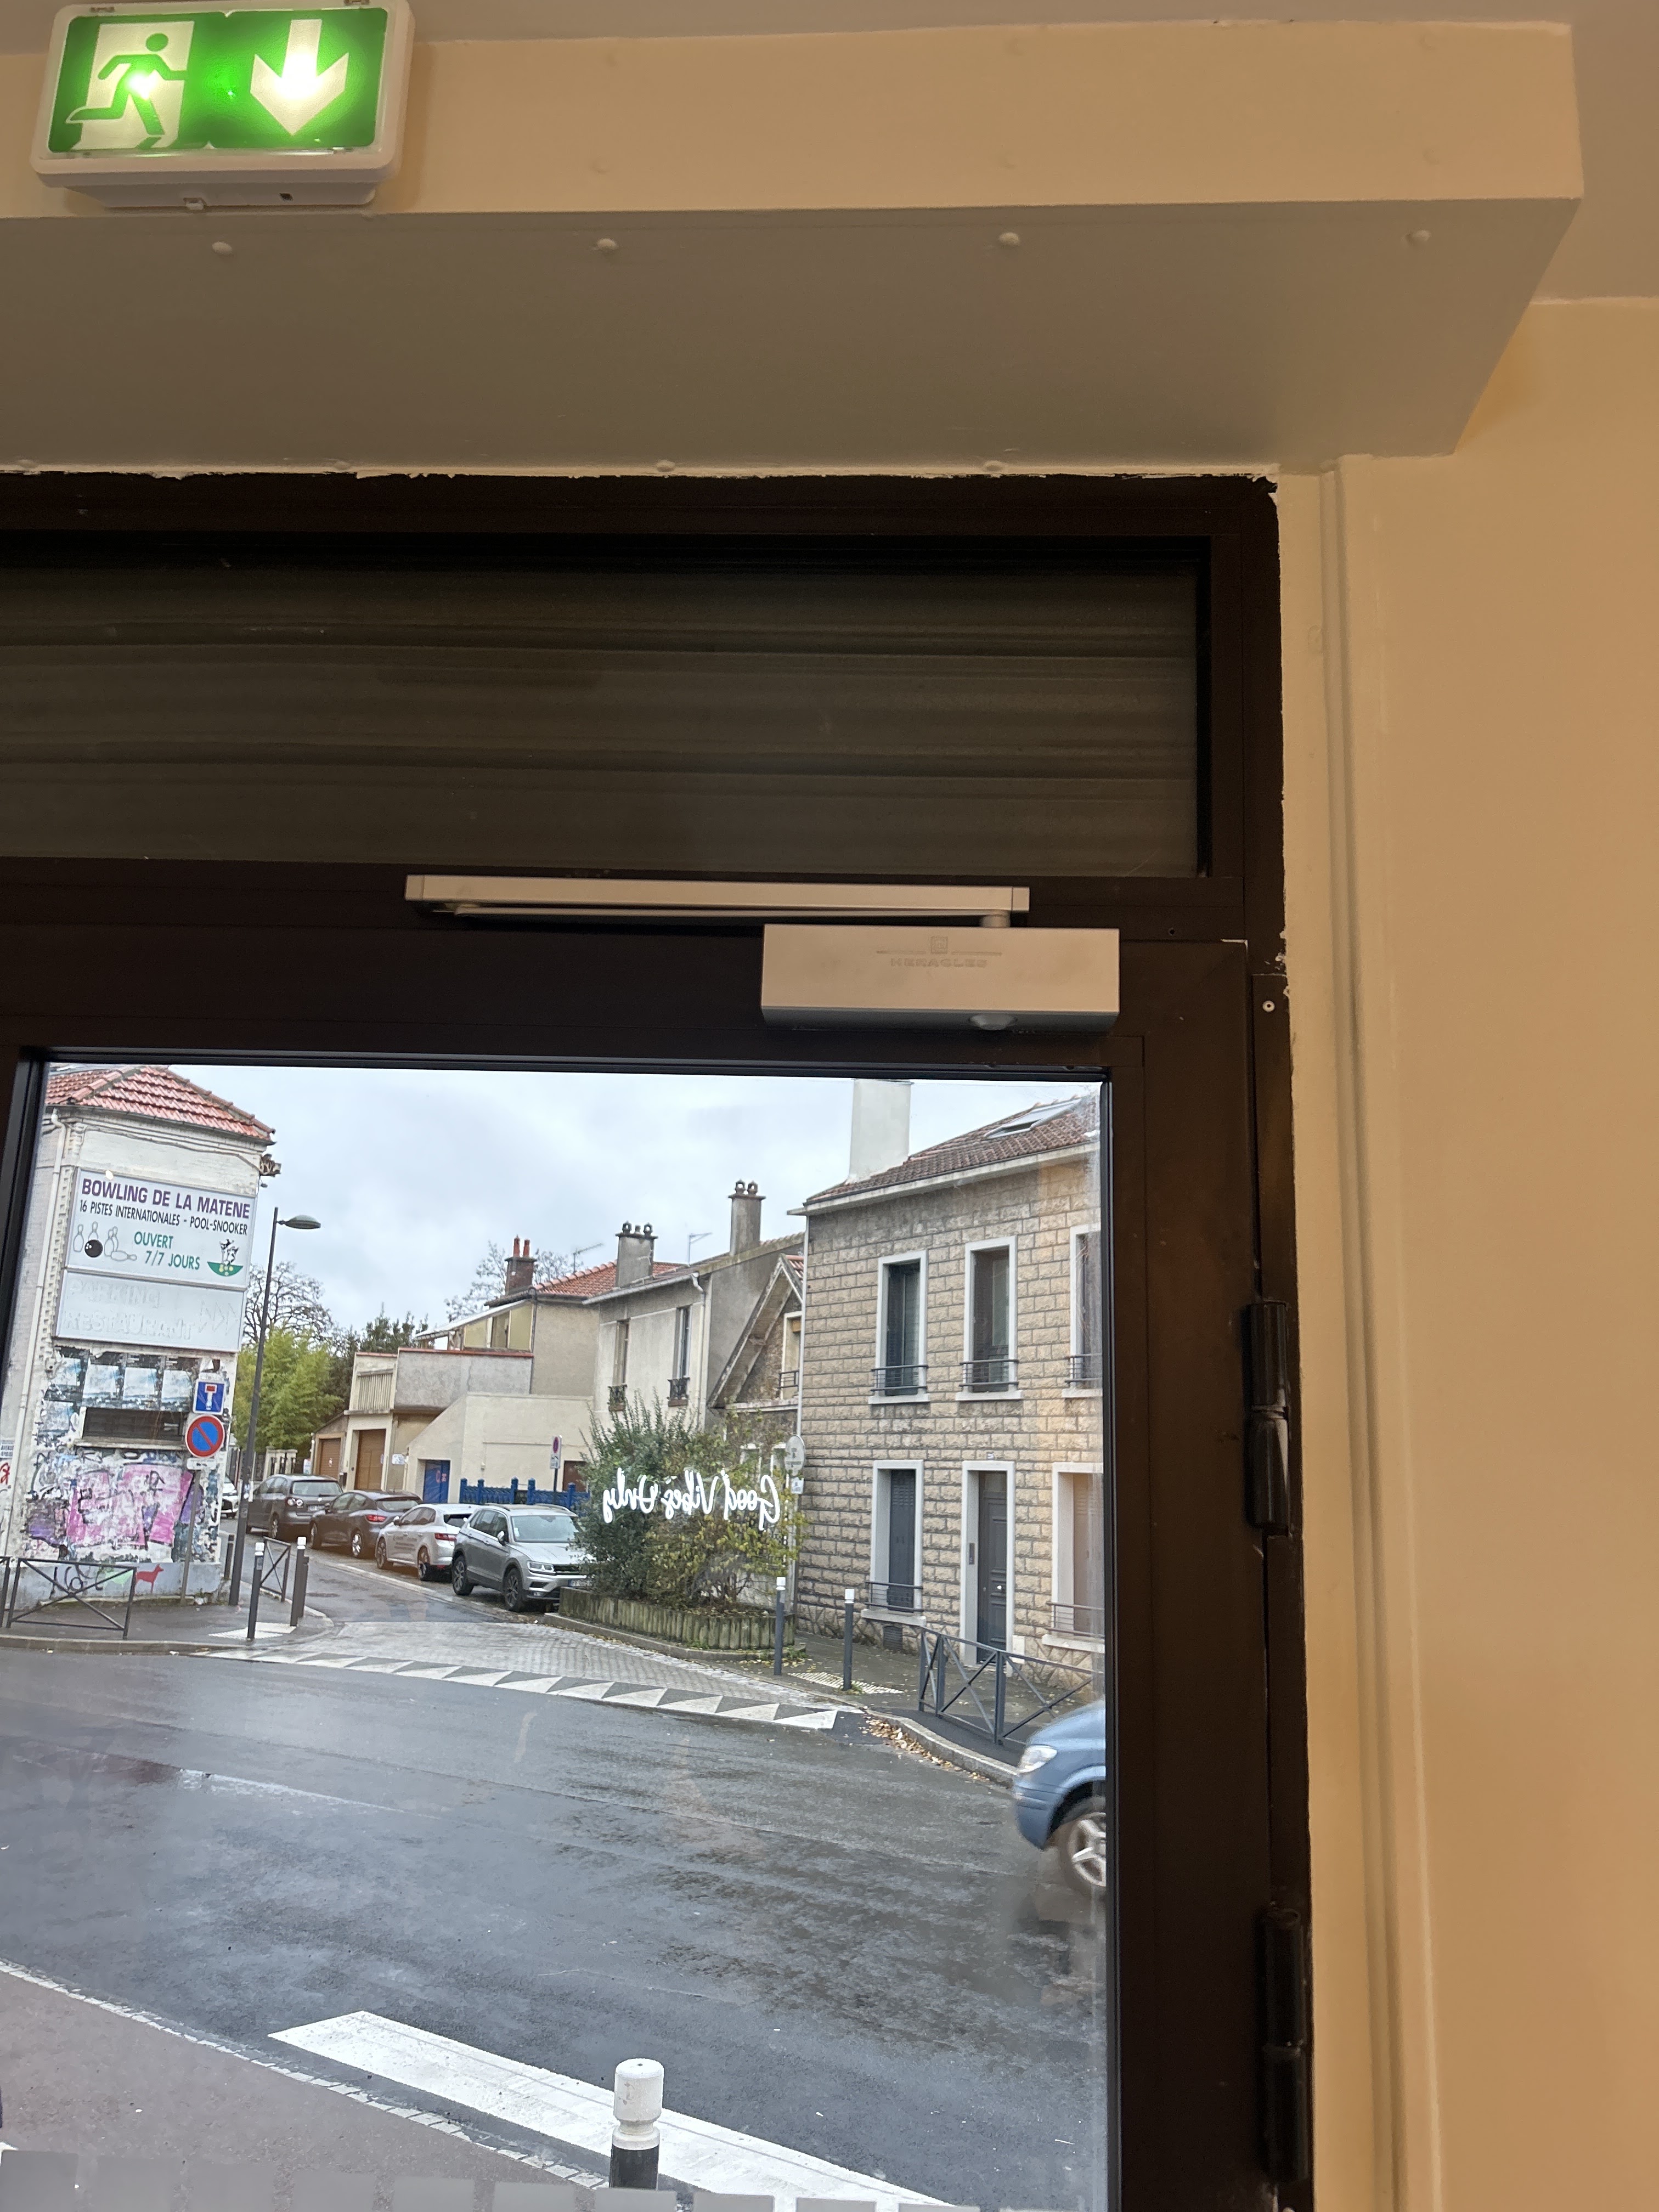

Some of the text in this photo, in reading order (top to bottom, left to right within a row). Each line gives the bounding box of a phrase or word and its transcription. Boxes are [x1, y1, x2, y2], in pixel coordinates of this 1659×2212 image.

[82, 1178, 250, 1219] BOWLING DE LA MATENE
[80, 1199, 87, 1212] 16
[90, 1201, 113, 1216] PISTES
[115, 1205, 180, 1226] INTERNATIONALES
[190, 1216, 247, 1235] POOL-SNOOKER
[134, 1231, 174, 1249] OUVERT
[145, 1250, 200, 1270] 7/7 JOURS
